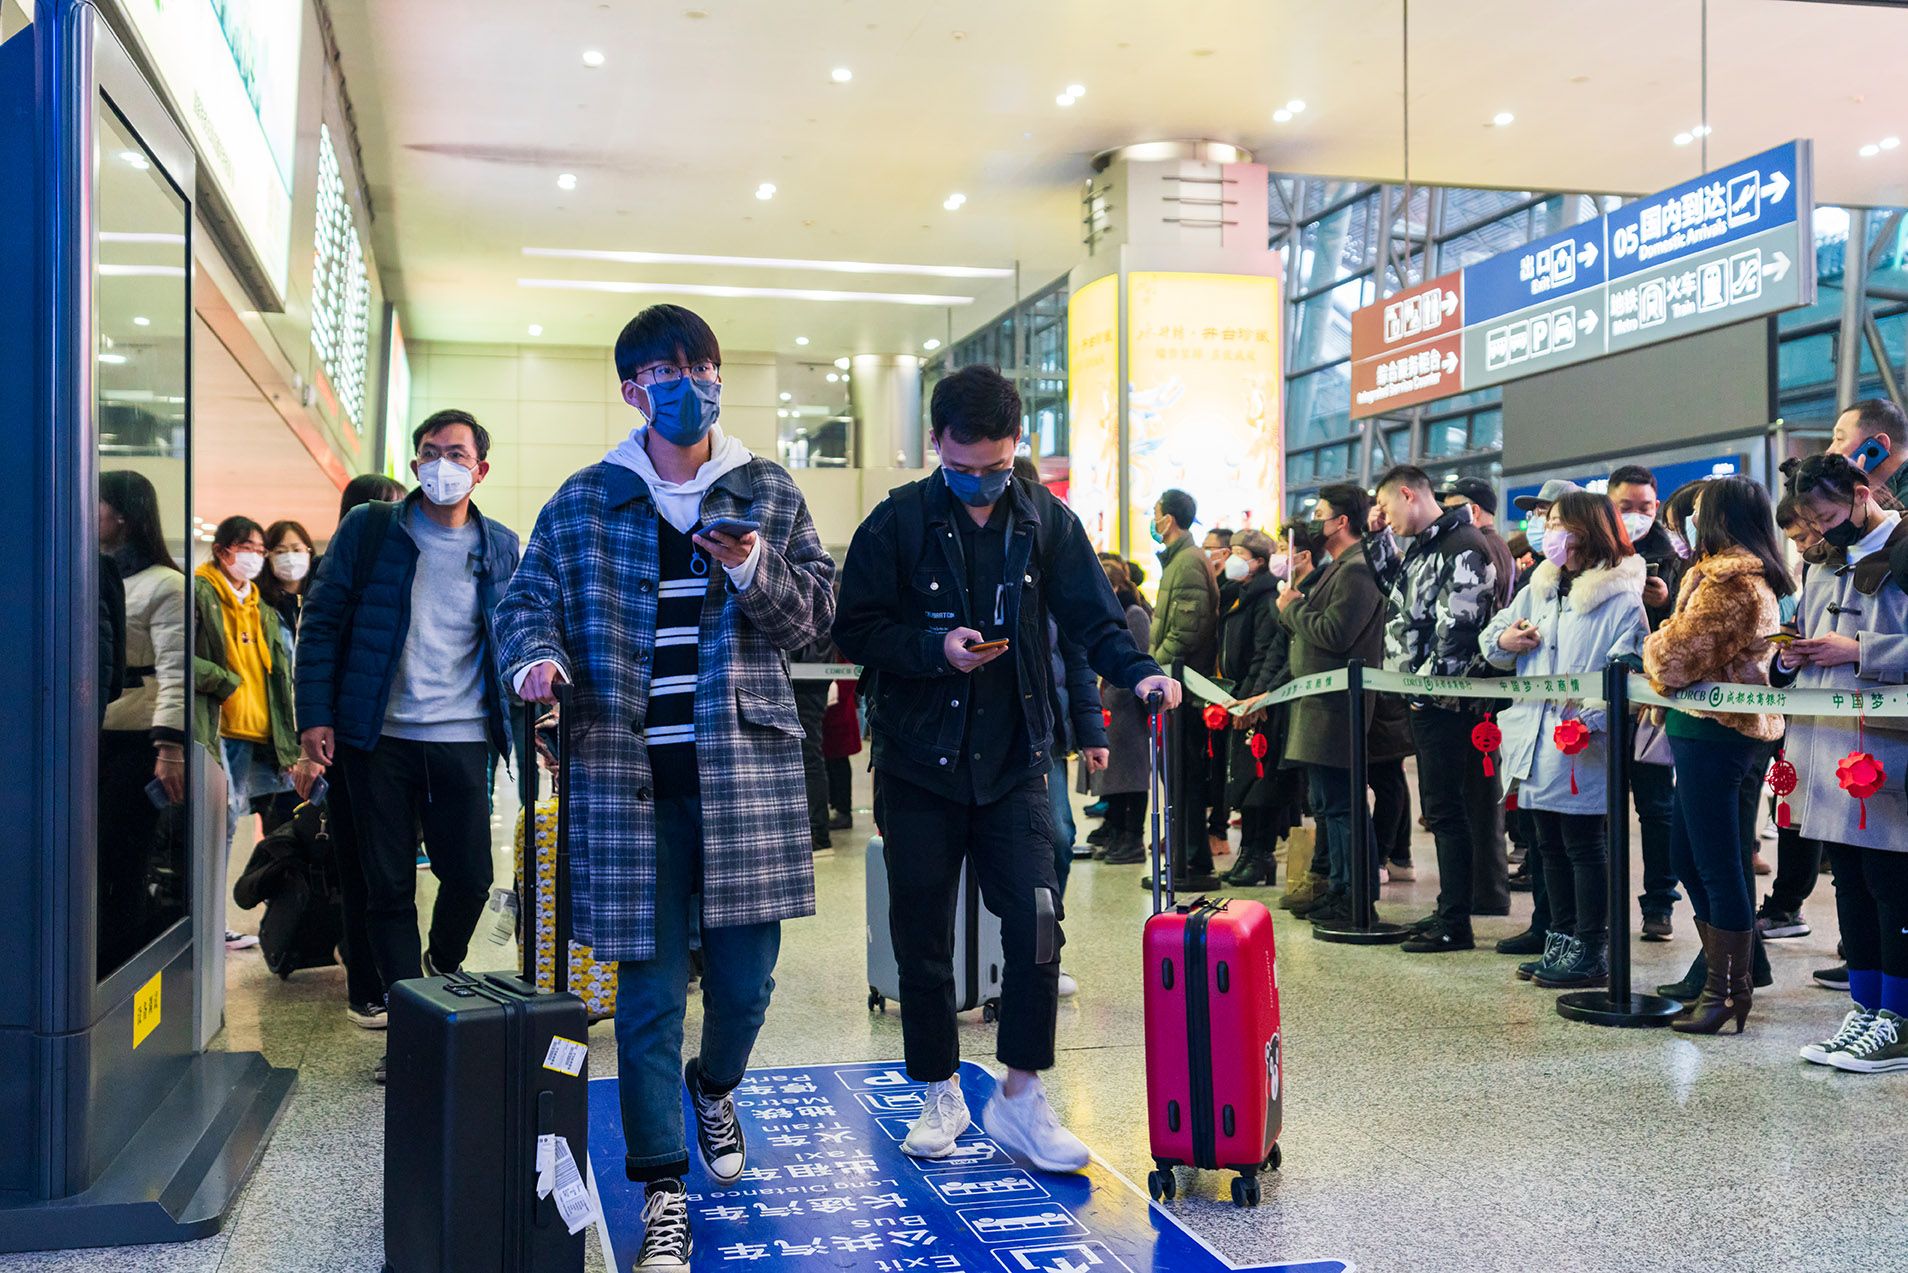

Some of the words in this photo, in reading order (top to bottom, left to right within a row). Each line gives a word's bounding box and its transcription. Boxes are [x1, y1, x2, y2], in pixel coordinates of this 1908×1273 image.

[1613, 223, 1639, 259] 05
[1640, 181, 1727, 244] 国内到达
[1638, 232, 1687, 261] Domestic
[1686, 218, 1728, 245] Arrivals
[1520, 249, 1550, 282] 出口
[1667, 271, 1697, 301] 火车
[1610, 287, 1638, 317] 地铁
[1671, 300, 1696, 319] Train
[1612, 317, 1638, 336] Metro
[1674, 690, 1706, 701] CDRCB
[1832, 692, 1908, 710] 中国梦·
[731, 1082, 818, 1095] 停车
[737, 1096, 831, 1107] Metro
[752, 1105, 837, 1120] 地铁
[762, 1121, 851, 1133] Train
[767, 1130, 857, 1147] 火车
[795, 1148, 873, 1161] Taxi
[741, 1159, 880, 1181] 出租车
[710, 1184, 826, 1198] Distance
[834, 1179, 899, 1190] Long
[700, 1192, 908, 1221] 长途汽车
[850, 1214, 928, 1227] Bus
[717, 1228, 938, 1260] 公共汽车
[874, 1254, 961, 1273] Exit
